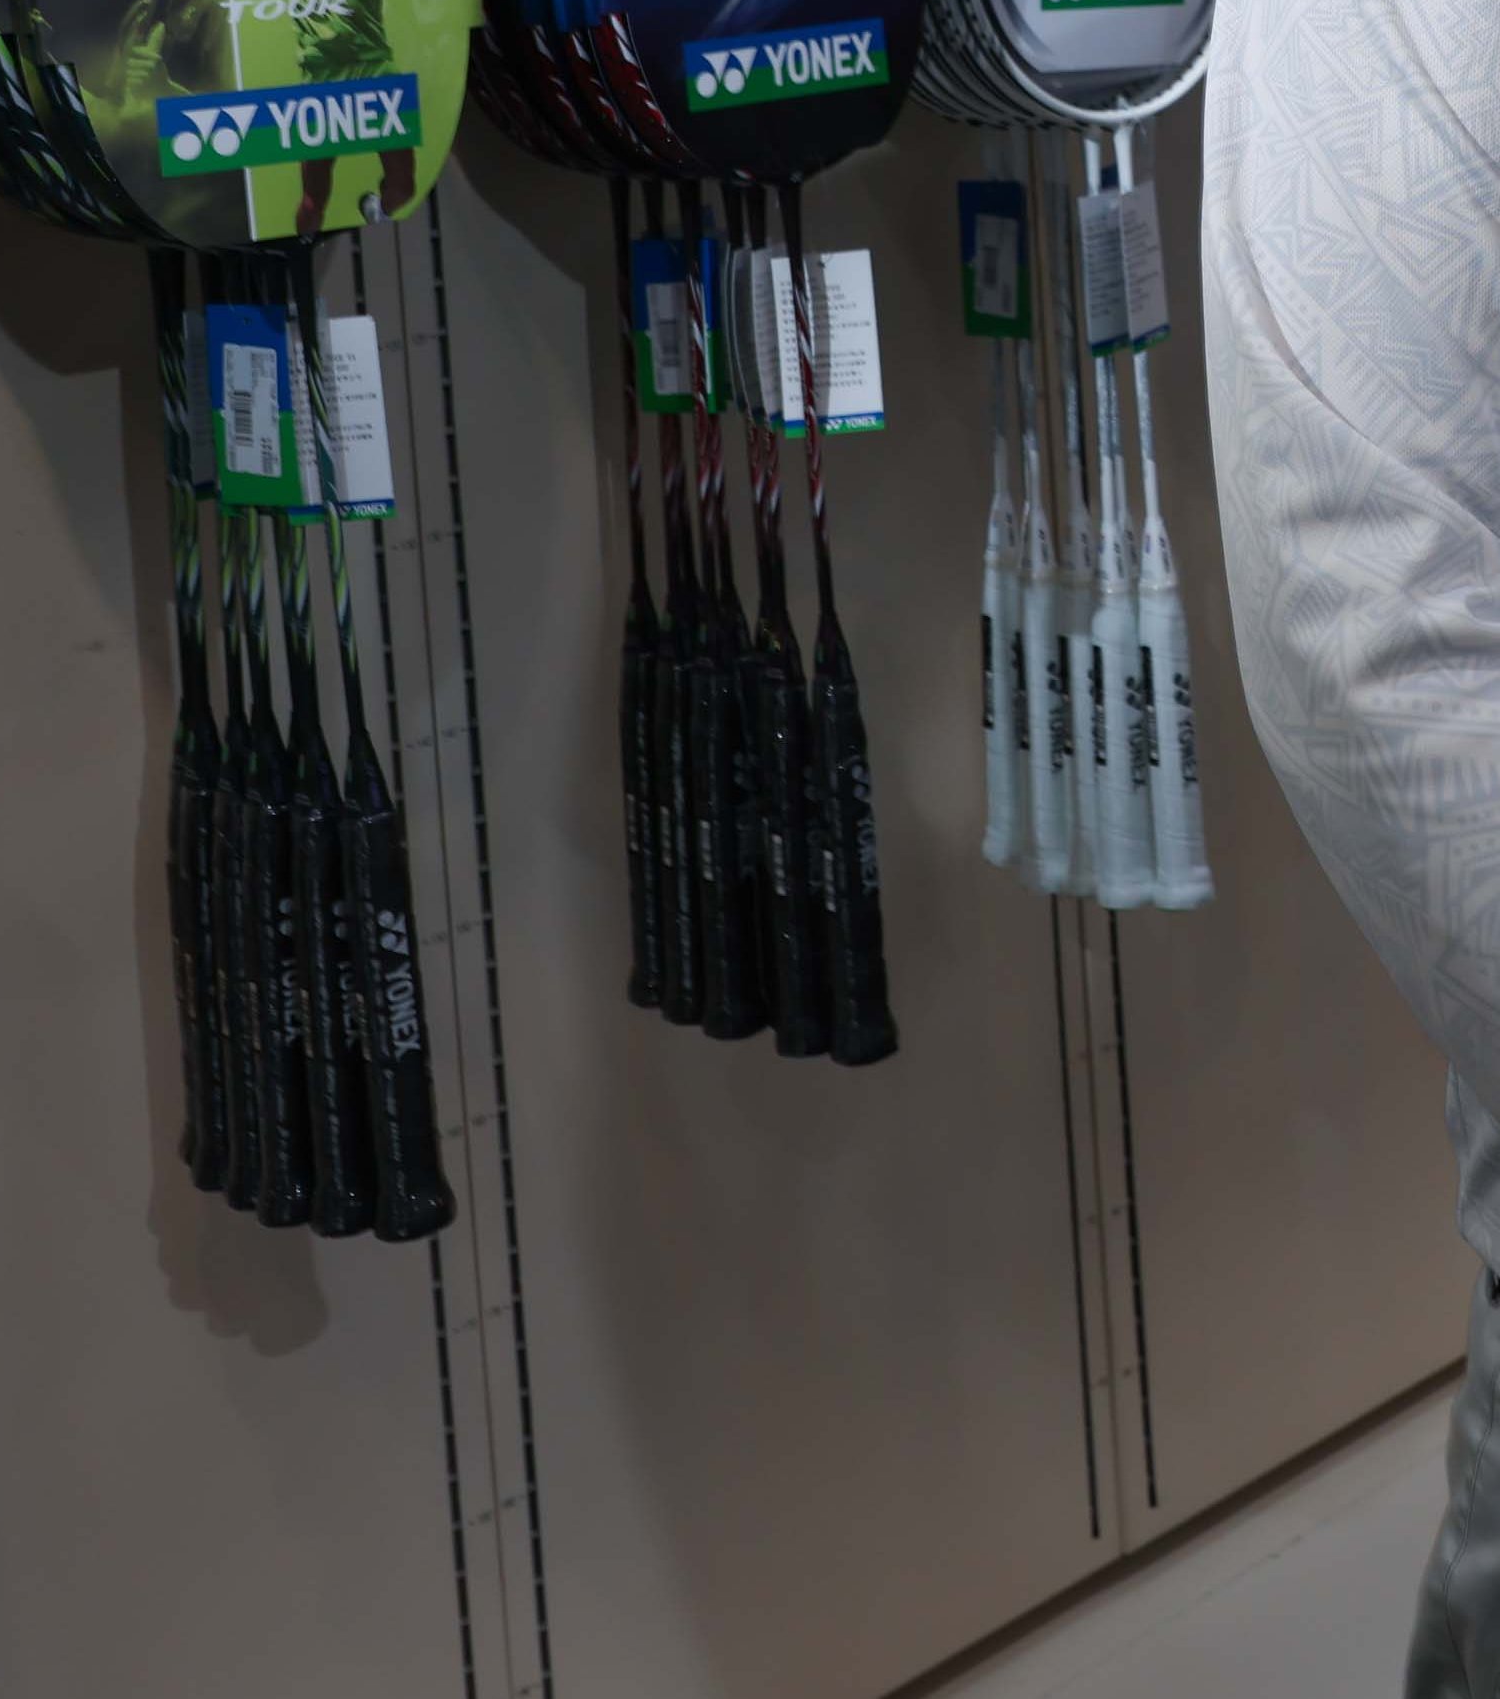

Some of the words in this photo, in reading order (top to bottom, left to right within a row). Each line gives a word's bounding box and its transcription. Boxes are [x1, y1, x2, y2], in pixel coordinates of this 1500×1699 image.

[763, 32, 877, 89] YONEX
[267, 88, 407, 151] YONEX
[353, 502, 389, 518] YONEX
[1176, 716, 1200, 791] YONEX
[384, 960, 423, 1064] YONEX
